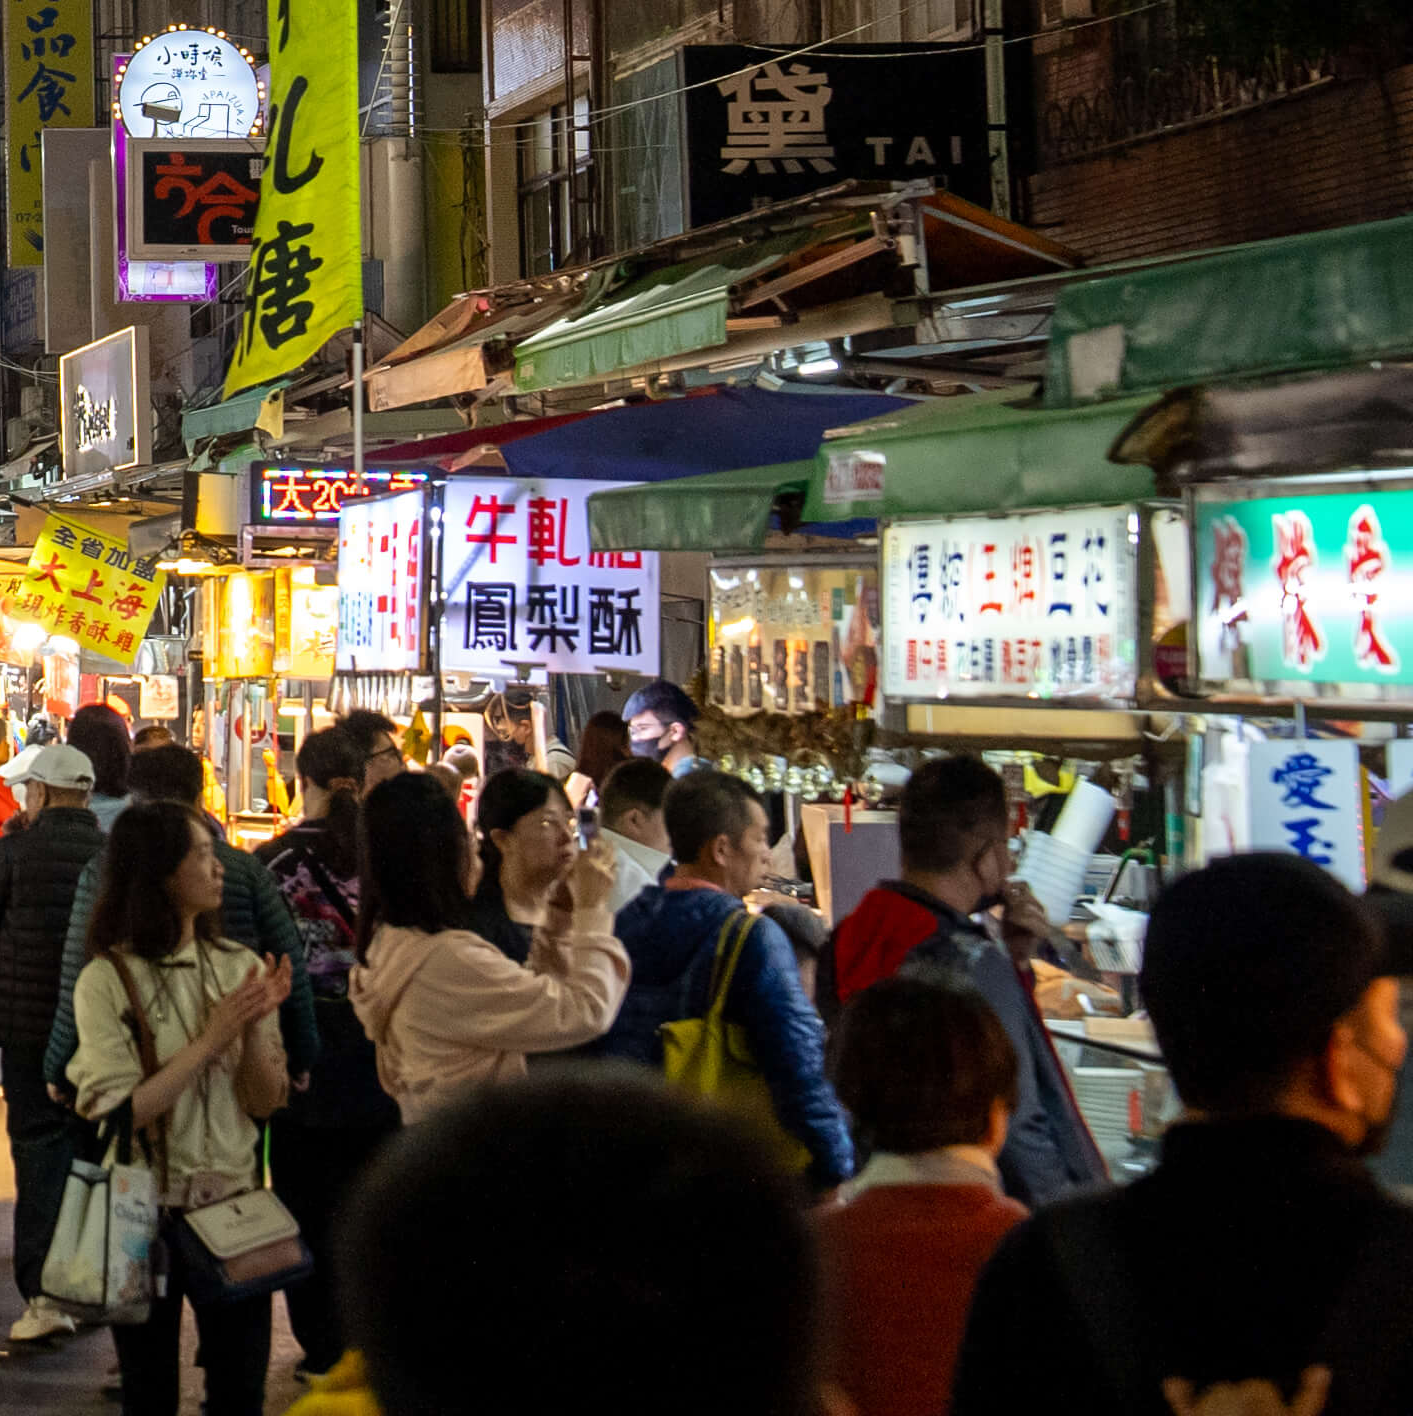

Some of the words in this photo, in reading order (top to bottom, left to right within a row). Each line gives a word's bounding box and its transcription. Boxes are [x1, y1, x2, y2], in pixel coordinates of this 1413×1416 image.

[866, 136, 962, 165] TAI
[465, 495, 642, 569] 牛軋
[34, 552, 147, 620] 大上海
[464, 582, 643, 657] 鳳梨酥
